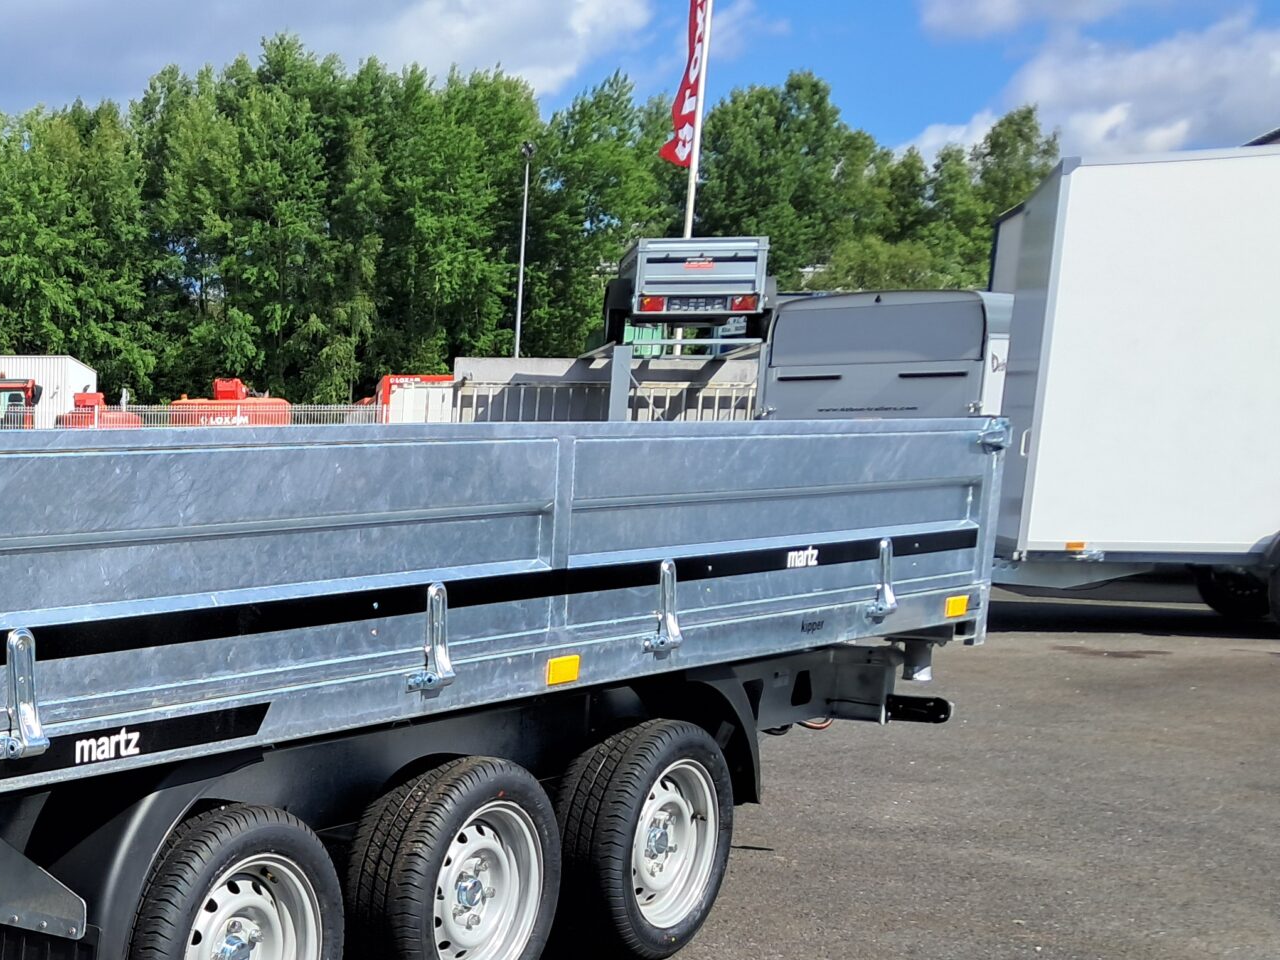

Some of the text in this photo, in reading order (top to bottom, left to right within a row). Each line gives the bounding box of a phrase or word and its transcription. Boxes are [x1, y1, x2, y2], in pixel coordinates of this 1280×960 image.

[680, 0, 705, 115] LOX
[787, 545, 818, 568] martz
[801, 620, 824, 635] kipper
[75, 726, 140, 764] martz
